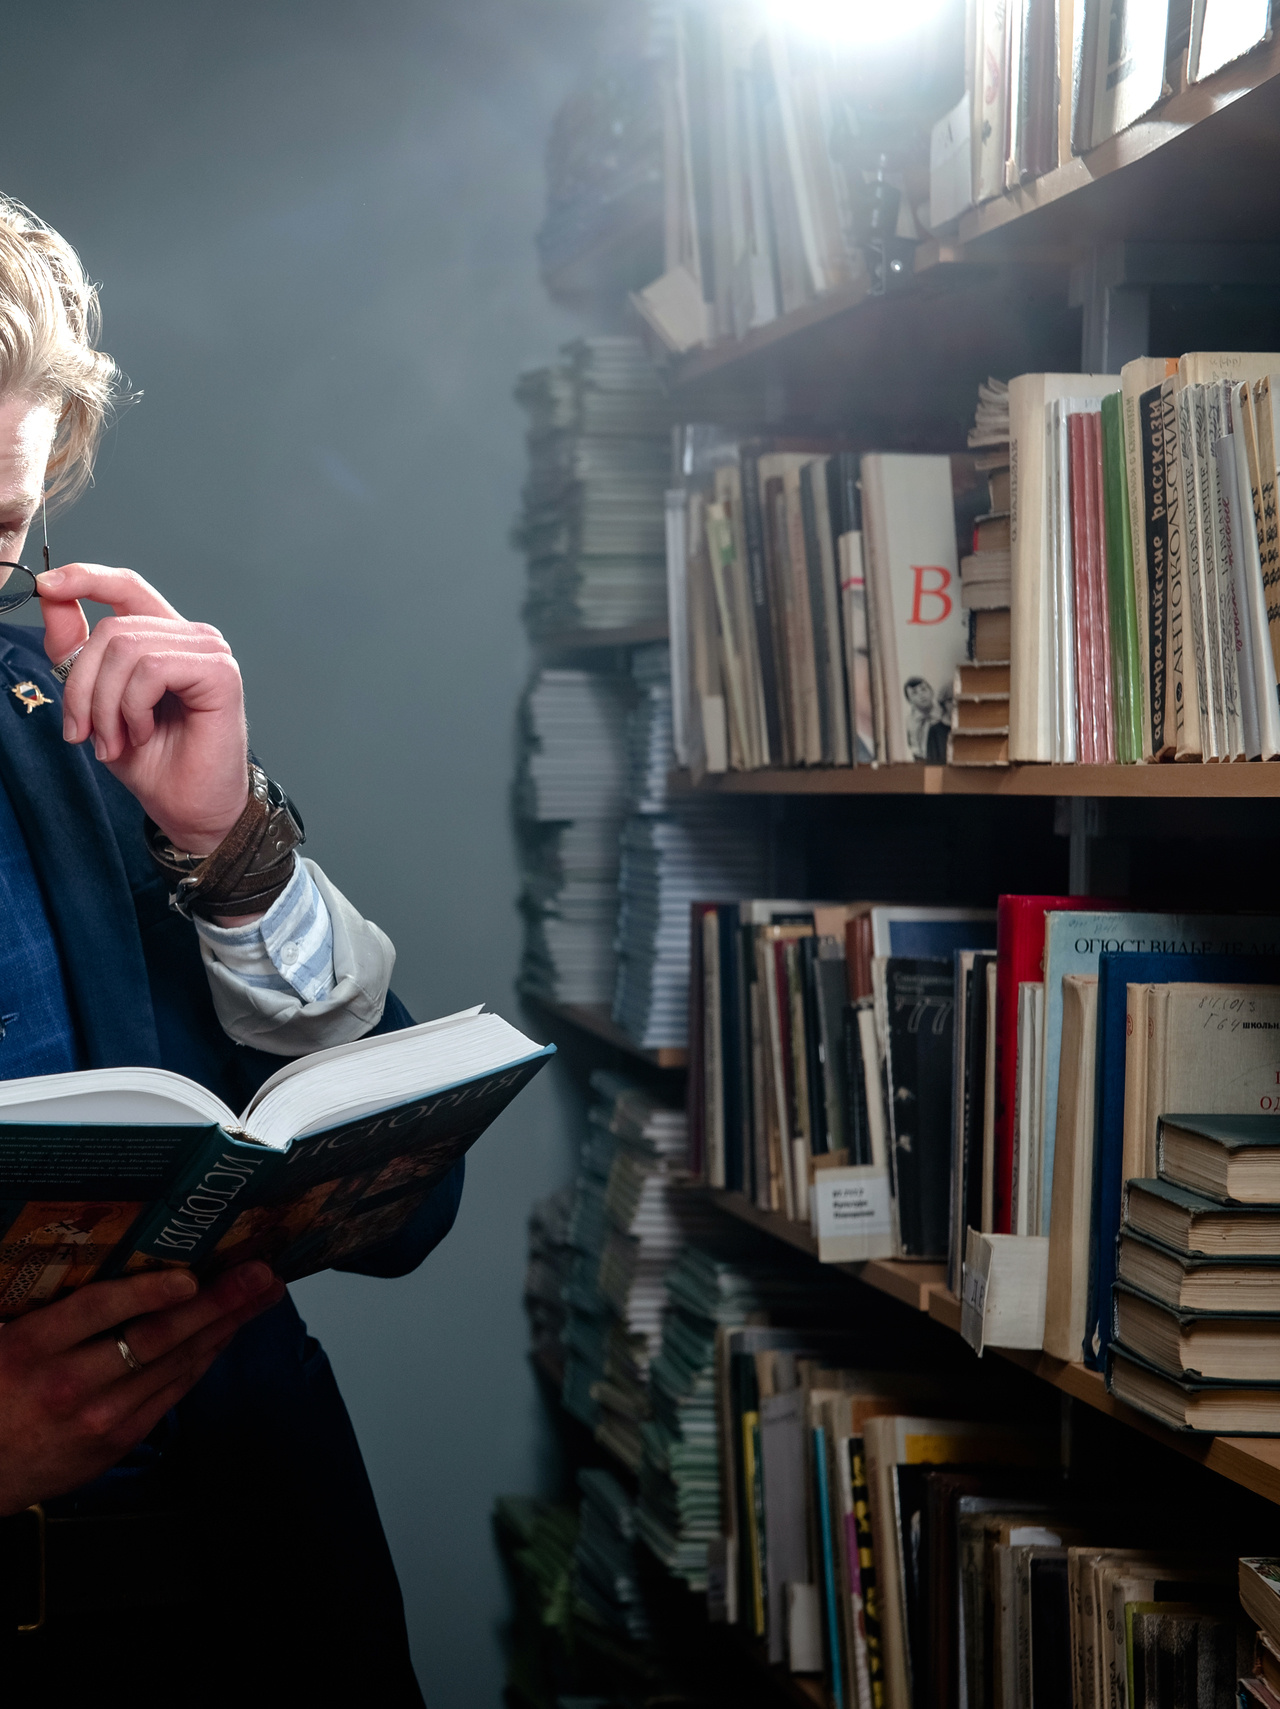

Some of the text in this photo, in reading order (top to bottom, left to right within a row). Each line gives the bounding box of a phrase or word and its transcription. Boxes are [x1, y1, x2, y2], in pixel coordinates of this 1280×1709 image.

[1162, 386, 1184, 675] АНТОКОЛЬСКИЙ
[1185, 462, 1201, 577] БОМАРШЕ
[1200, 461, 1214, 576] БОМАРШЕ
[907, 564, 953, 626] В
[1149, 398, 1167, 741] австралийские рассказы
[1075, 938, 1145, 955] ОГЮСТ
[1150, 939, 1213, 955] ВИЛЬЕ
[1248, 942, 1280, 957] ЛИ
[1242, 1020, 1280, 1031] школьн
[287, 1067, 524, 1166] ИСТОРИЯ
[153, 1152, 265, 1253] ИСТОРИЯ
[1109, 1660, 1118, 1709] ОРКА
